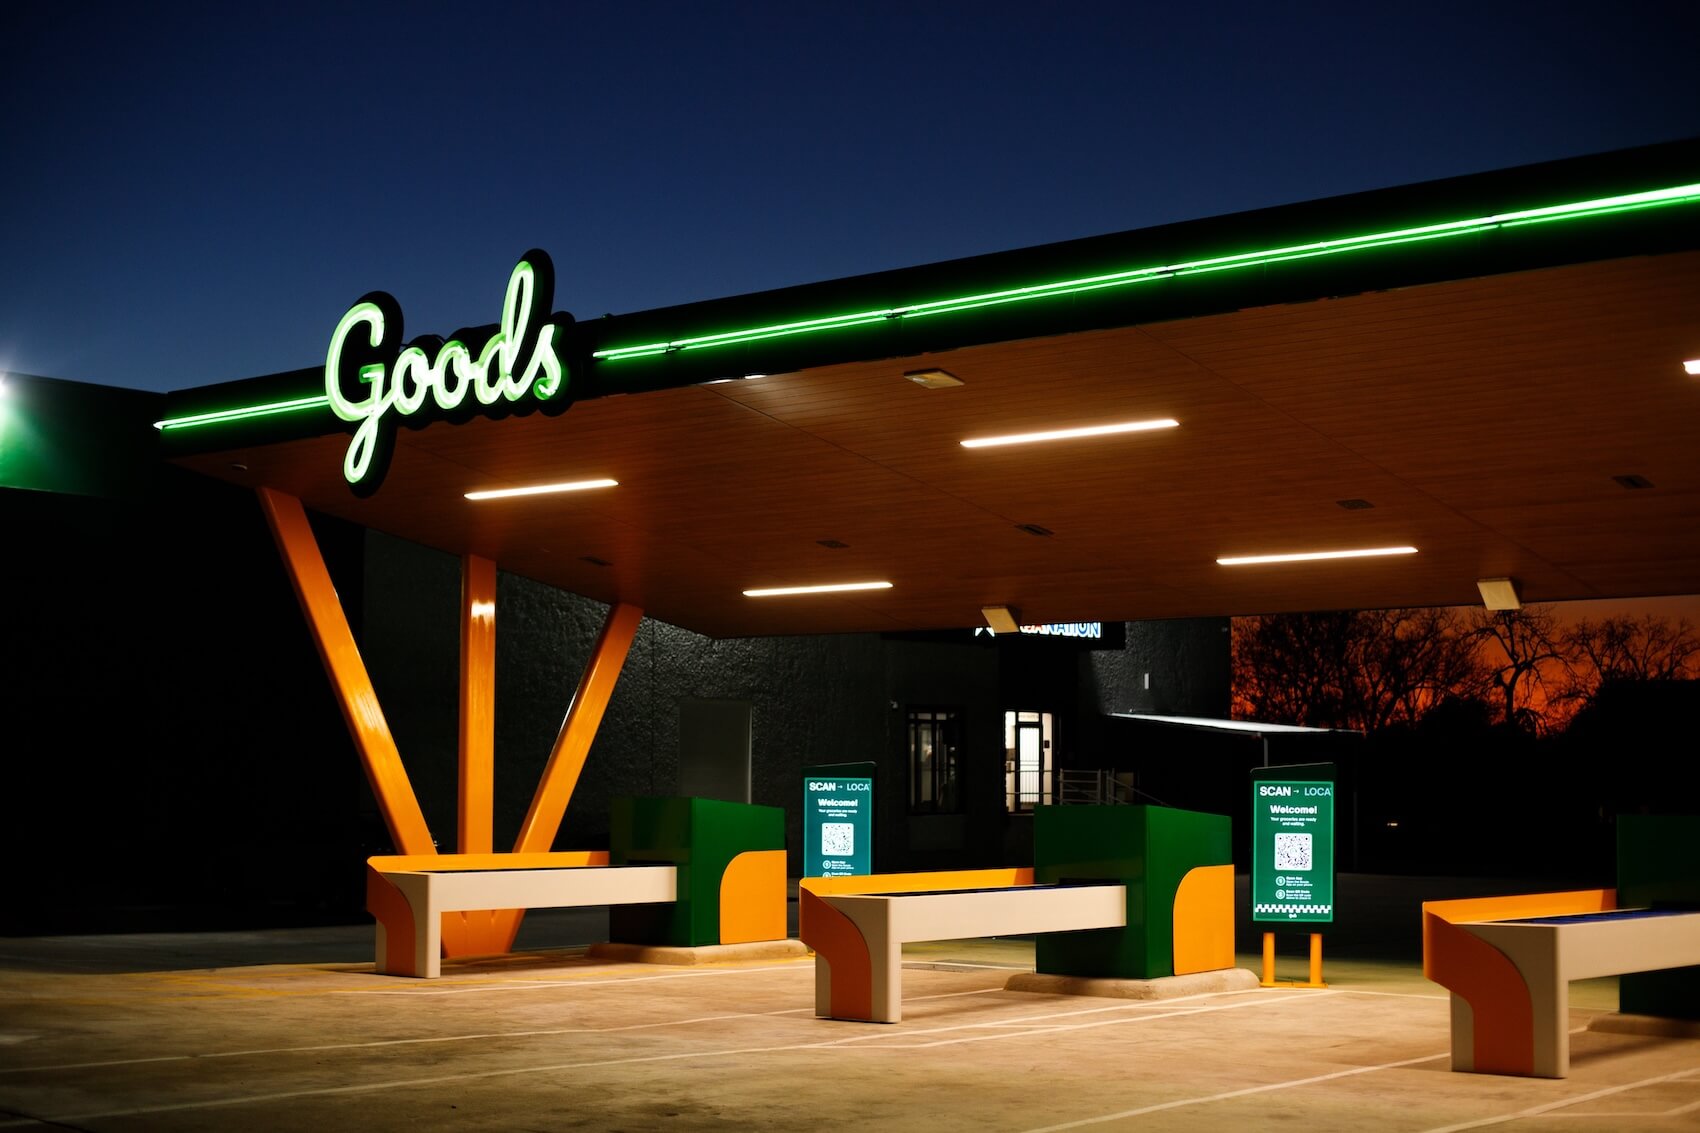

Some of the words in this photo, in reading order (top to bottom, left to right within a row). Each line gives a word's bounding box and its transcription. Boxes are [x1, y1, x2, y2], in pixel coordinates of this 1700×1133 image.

[325, 260, 562, 484] Goods
[809, 782, 836, 791] SCAN
[846, 783, 870, 791] LOCA
[1260, 786, 1291, 796] SCAN
[1304, 787, 1332, 796] LOCA
[818, 799, 858, 807] Welcome!
[1270, 805, 1317, 814] Welcome!
